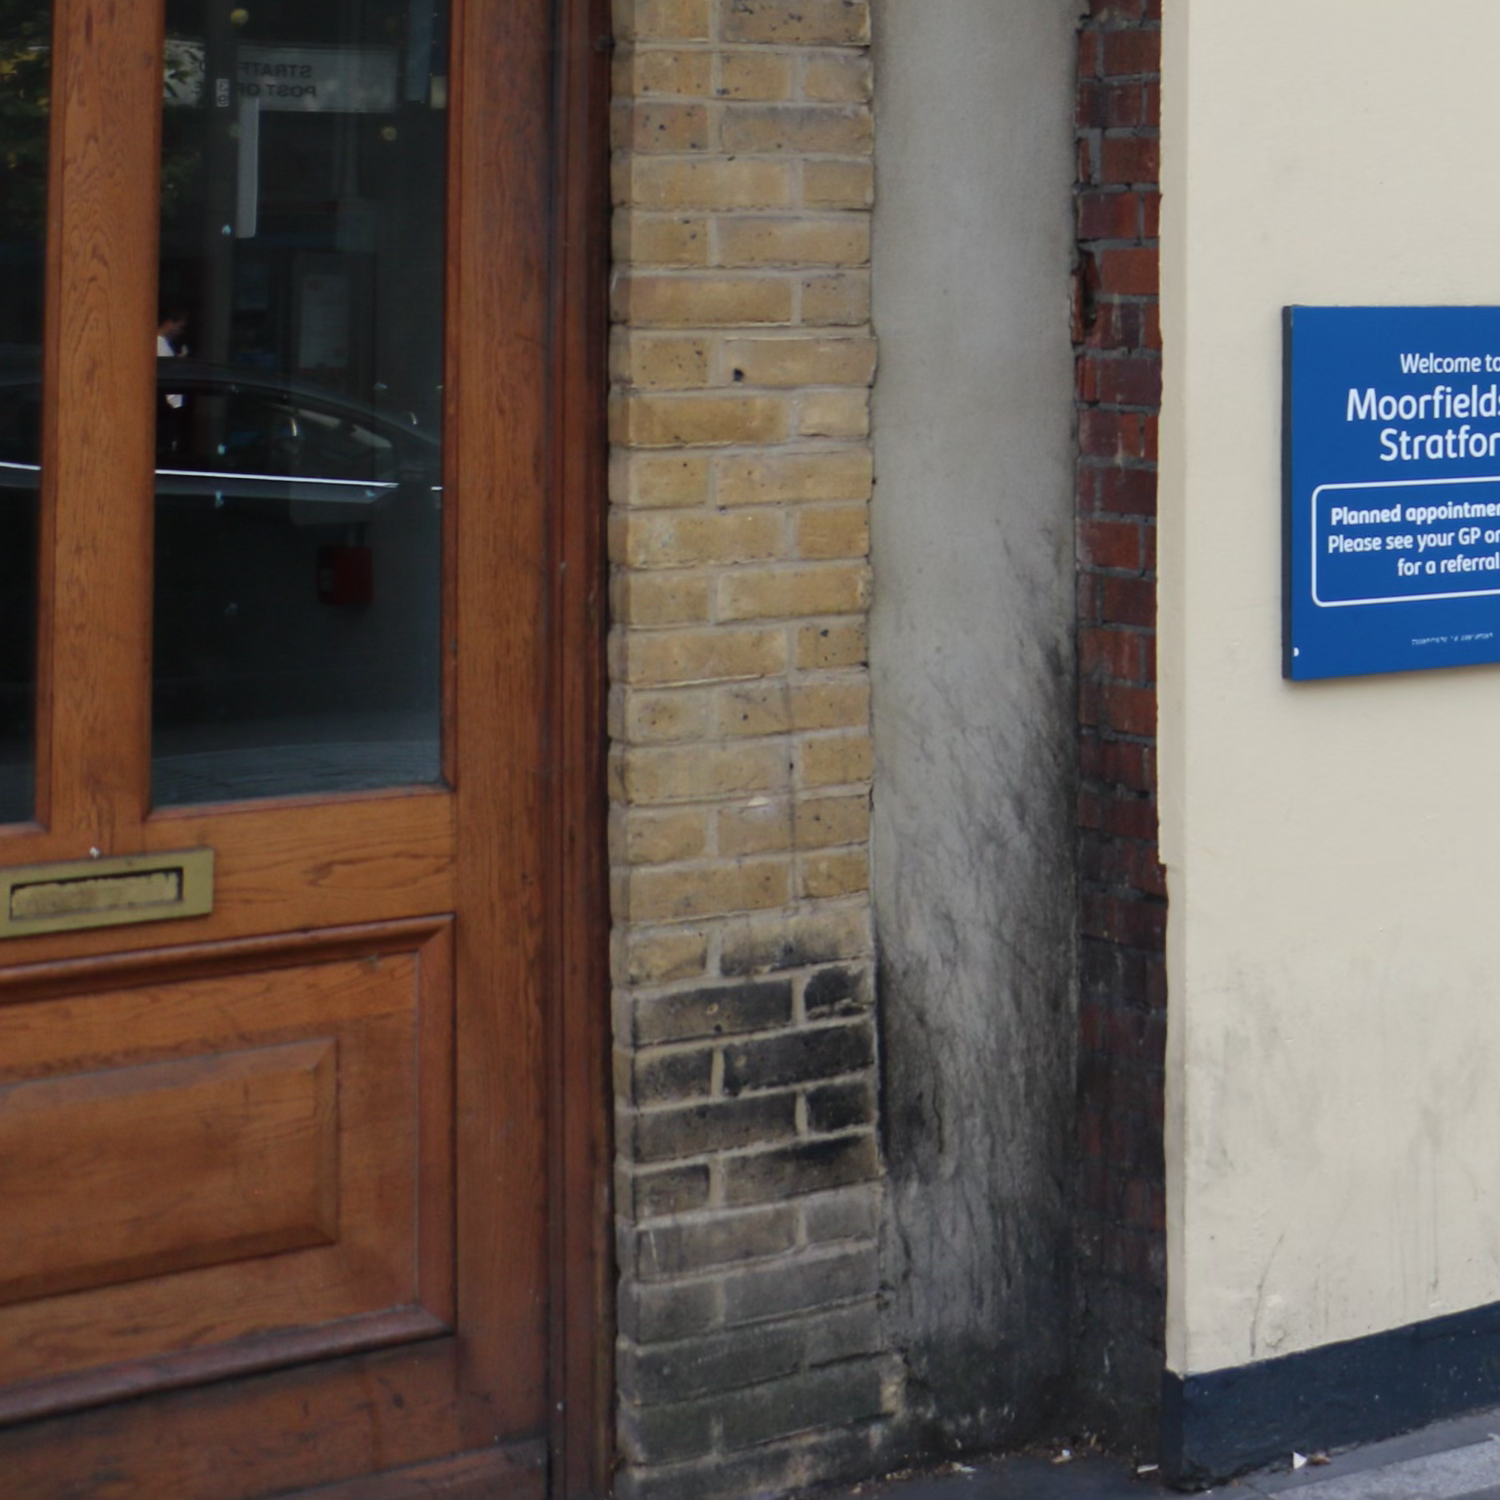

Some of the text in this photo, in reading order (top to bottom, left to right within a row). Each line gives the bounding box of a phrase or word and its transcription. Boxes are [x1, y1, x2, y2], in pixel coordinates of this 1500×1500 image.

[1400, 353, 1482, 374] Welcome
[1330, 504, 1401, 526] Planned
[1328, 533, 1382, 554] Please
[1385, 532, 1414, 550] see
[1417, 529, 1455, 552] your
[1458, 527, 1481, 546] GP
[1397, 557, 1422, 576] for
[1425, 560, 1436, 575] a
